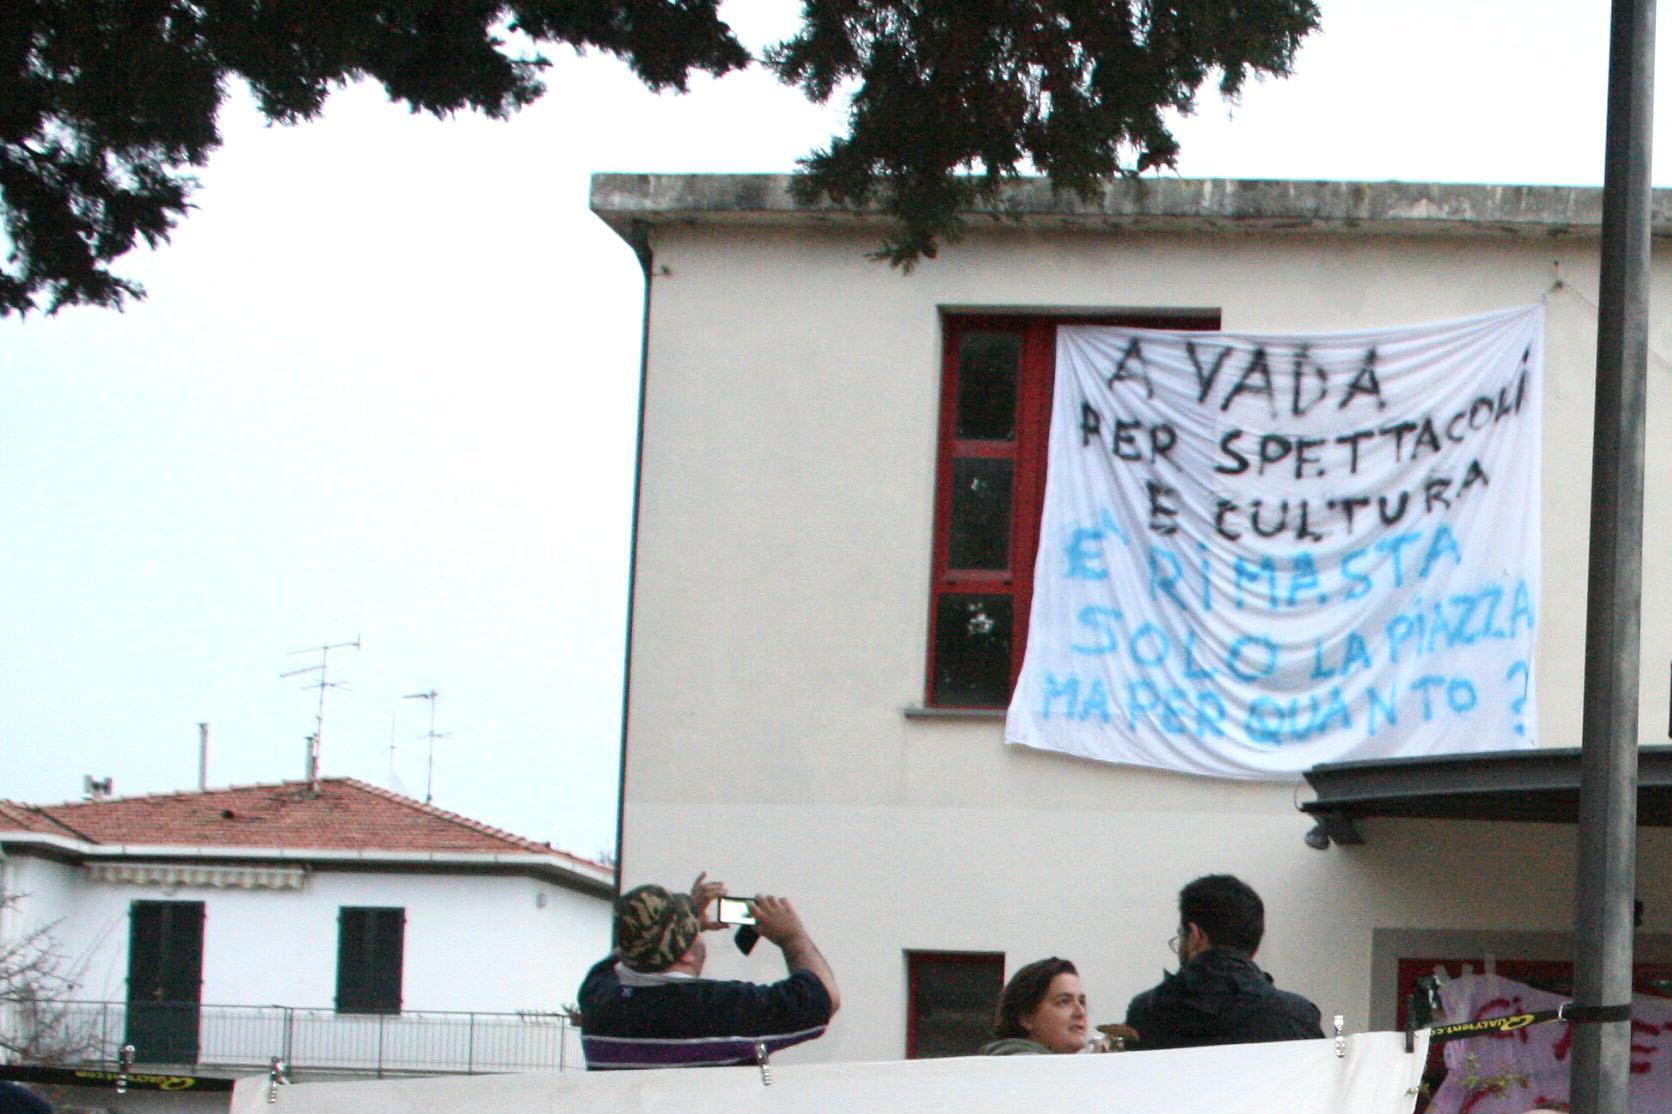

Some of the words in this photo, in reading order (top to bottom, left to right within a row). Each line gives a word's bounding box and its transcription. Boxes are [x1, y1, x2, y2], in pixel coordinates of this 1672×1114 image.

[1081, 404, 1180, 472] PER
[1214, 343, 1531, 481] SPETTACOLI
[1108, 337, 1155, 400] A
[1187, 340, 1387, 417] VADA
[1147, 479, 1180, 535] E
[1214, 459, 1489, 541] CULTURA
[1150, 523, 1461, 612] RIMASTA
[1071, 604, 1277, 683] SOLO
[1310, 630, 1373, 679] LA
[1384, 579, 1536, 663] PIAZZA
[1041, 670, 1112, 723] MA
[1127, 680, 1226, 738] PER
[1244, 674, 1477, 746] QUANTO
